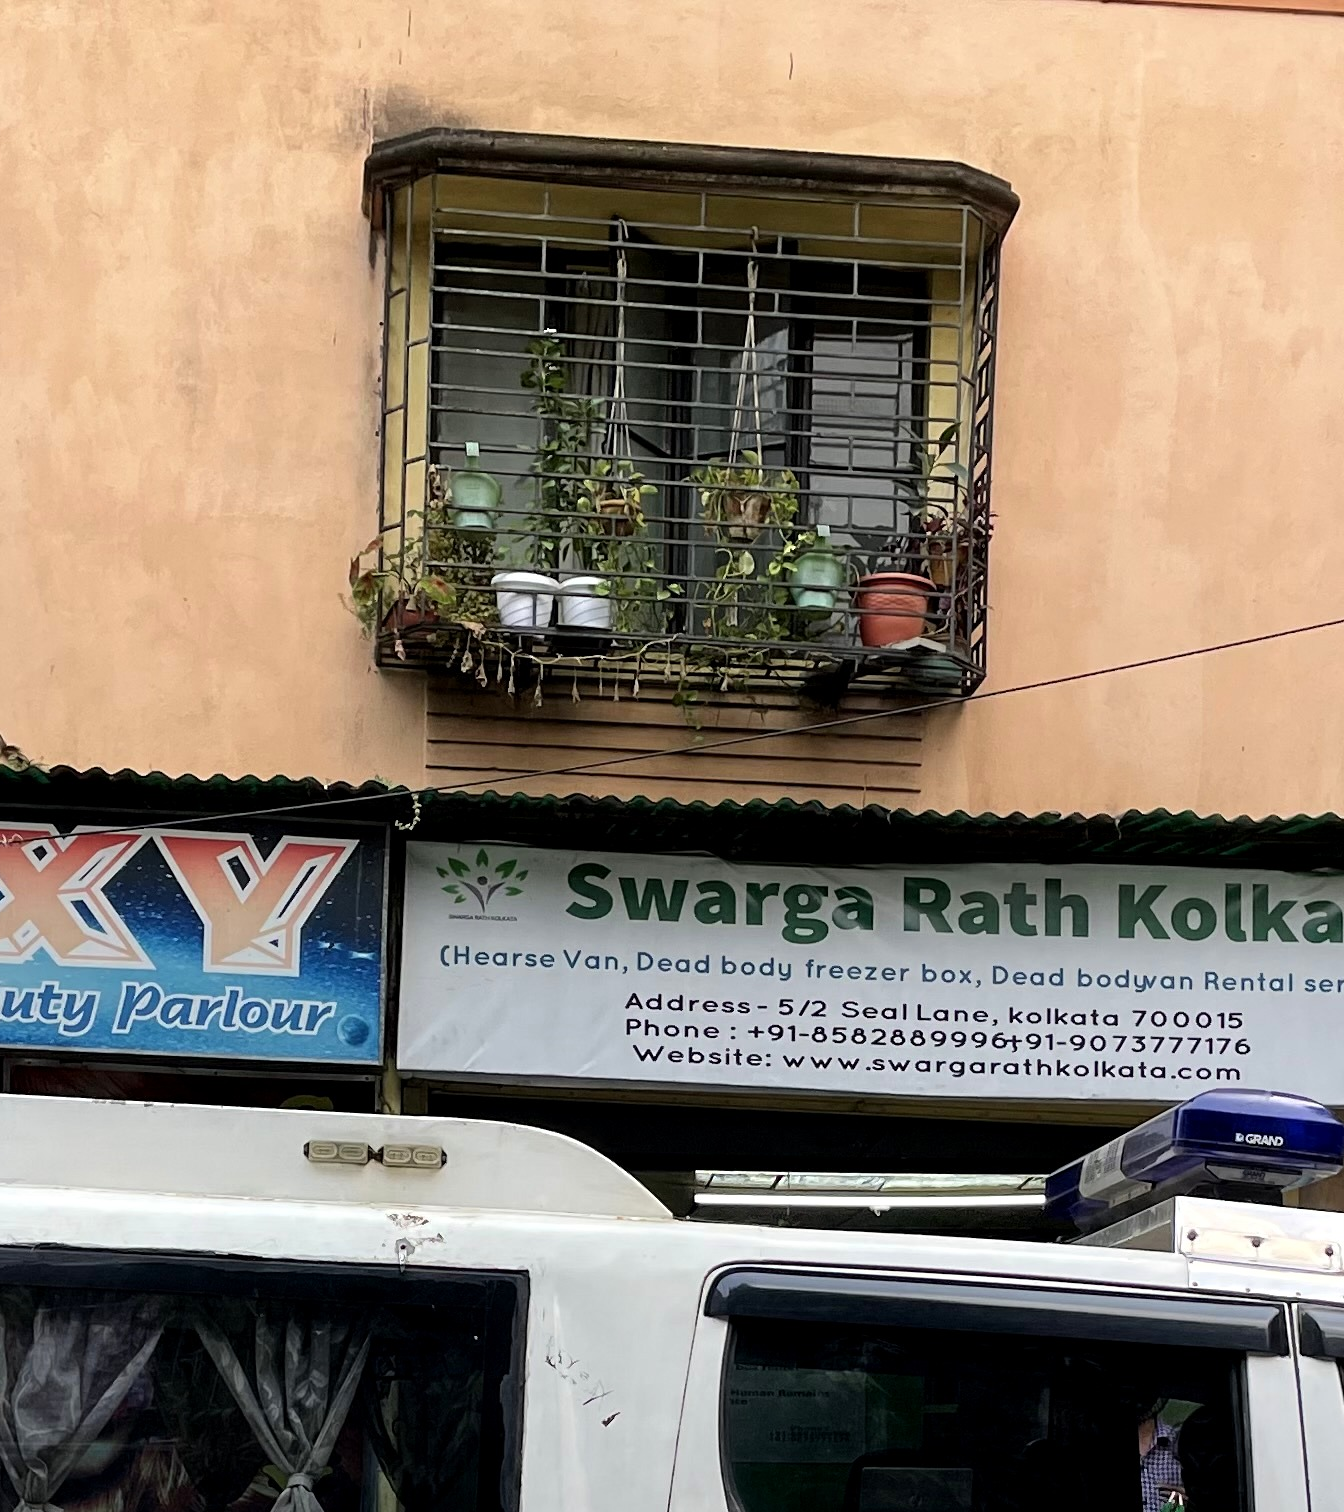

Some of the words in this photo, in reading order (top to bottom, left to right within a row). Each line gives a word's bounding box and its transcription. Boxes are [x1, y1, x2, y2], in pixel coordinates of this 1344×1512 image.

[565, 862, 875, 945] Swarga
[902, 876, 1090, 938] Rath
[440, 945, 556, 968] (Hearse
[562, 949, 628, 975] Van,
[636, 951, 710, 974] Dead
[721, 954, 792, 982] body
[805, 958, 910, 982] freezer
[921, 963, 982, 989] box,
[992, 965, 1064, 987] Dead
[1204, 971, 1293, 992] Rental
[111, 983, 336, 1034] Parlour
[778, 998, 827, 1018] 5/2
[841, 1000, 908, 1021] Seal
[916, 1003, 999, 1027] Lane,
[1008, 1006, 1119, 1027] kolkata
[1131, 1009, 1244, 1030] 700015
[632, 1044, 772, 1068] Website:
[782, 1054, 1241, 1081] www.swargarathkolkata.com
[1245, 1133, 1284, 1148] GRAND
